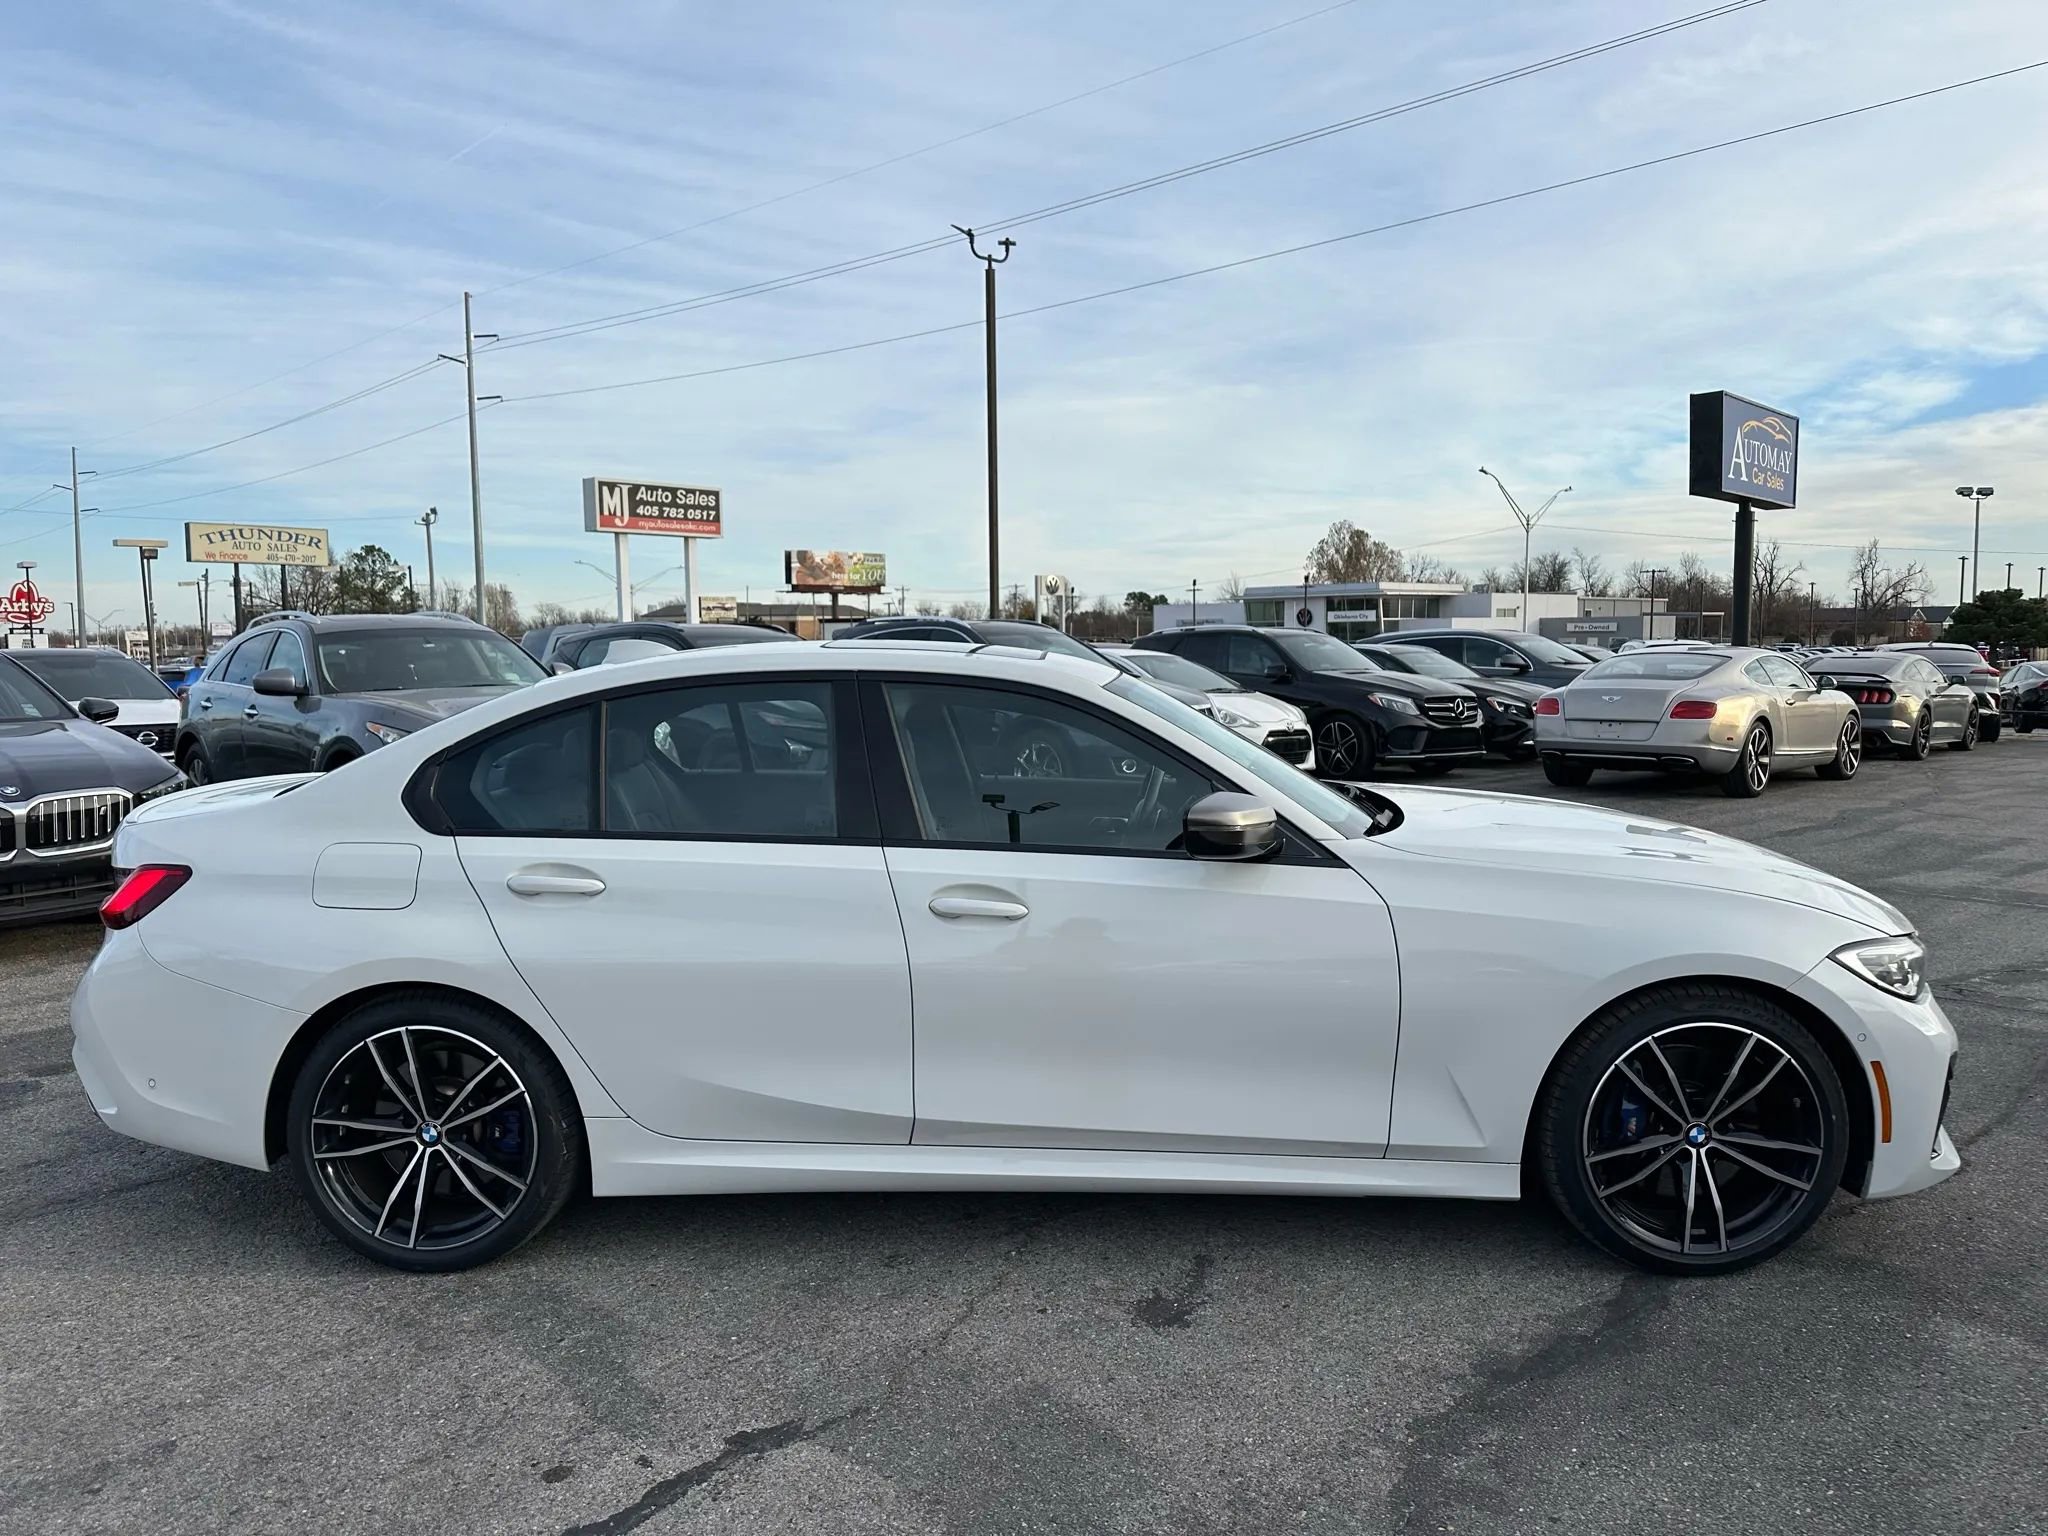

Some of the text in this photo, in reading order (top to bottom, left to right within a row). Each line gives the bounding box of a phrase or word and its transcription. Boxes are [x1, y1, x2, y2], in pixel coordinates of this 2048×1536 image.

[1728, 426, 1792, 481] AUTOMAY
[1752, 467, 1784, 491] Car Sales
[602, 484, 632, 527] MJ
[636, 486, 716, 507] Auto Sales
[636, 505, 716, 520] 405 782 0517
[199, 528, 323, 550] THUNDER
[232, 541, 298, 553] AUTO SALES
[205, 551, 248, 560] We Finance
[862, 568, 885, 581] YOU
